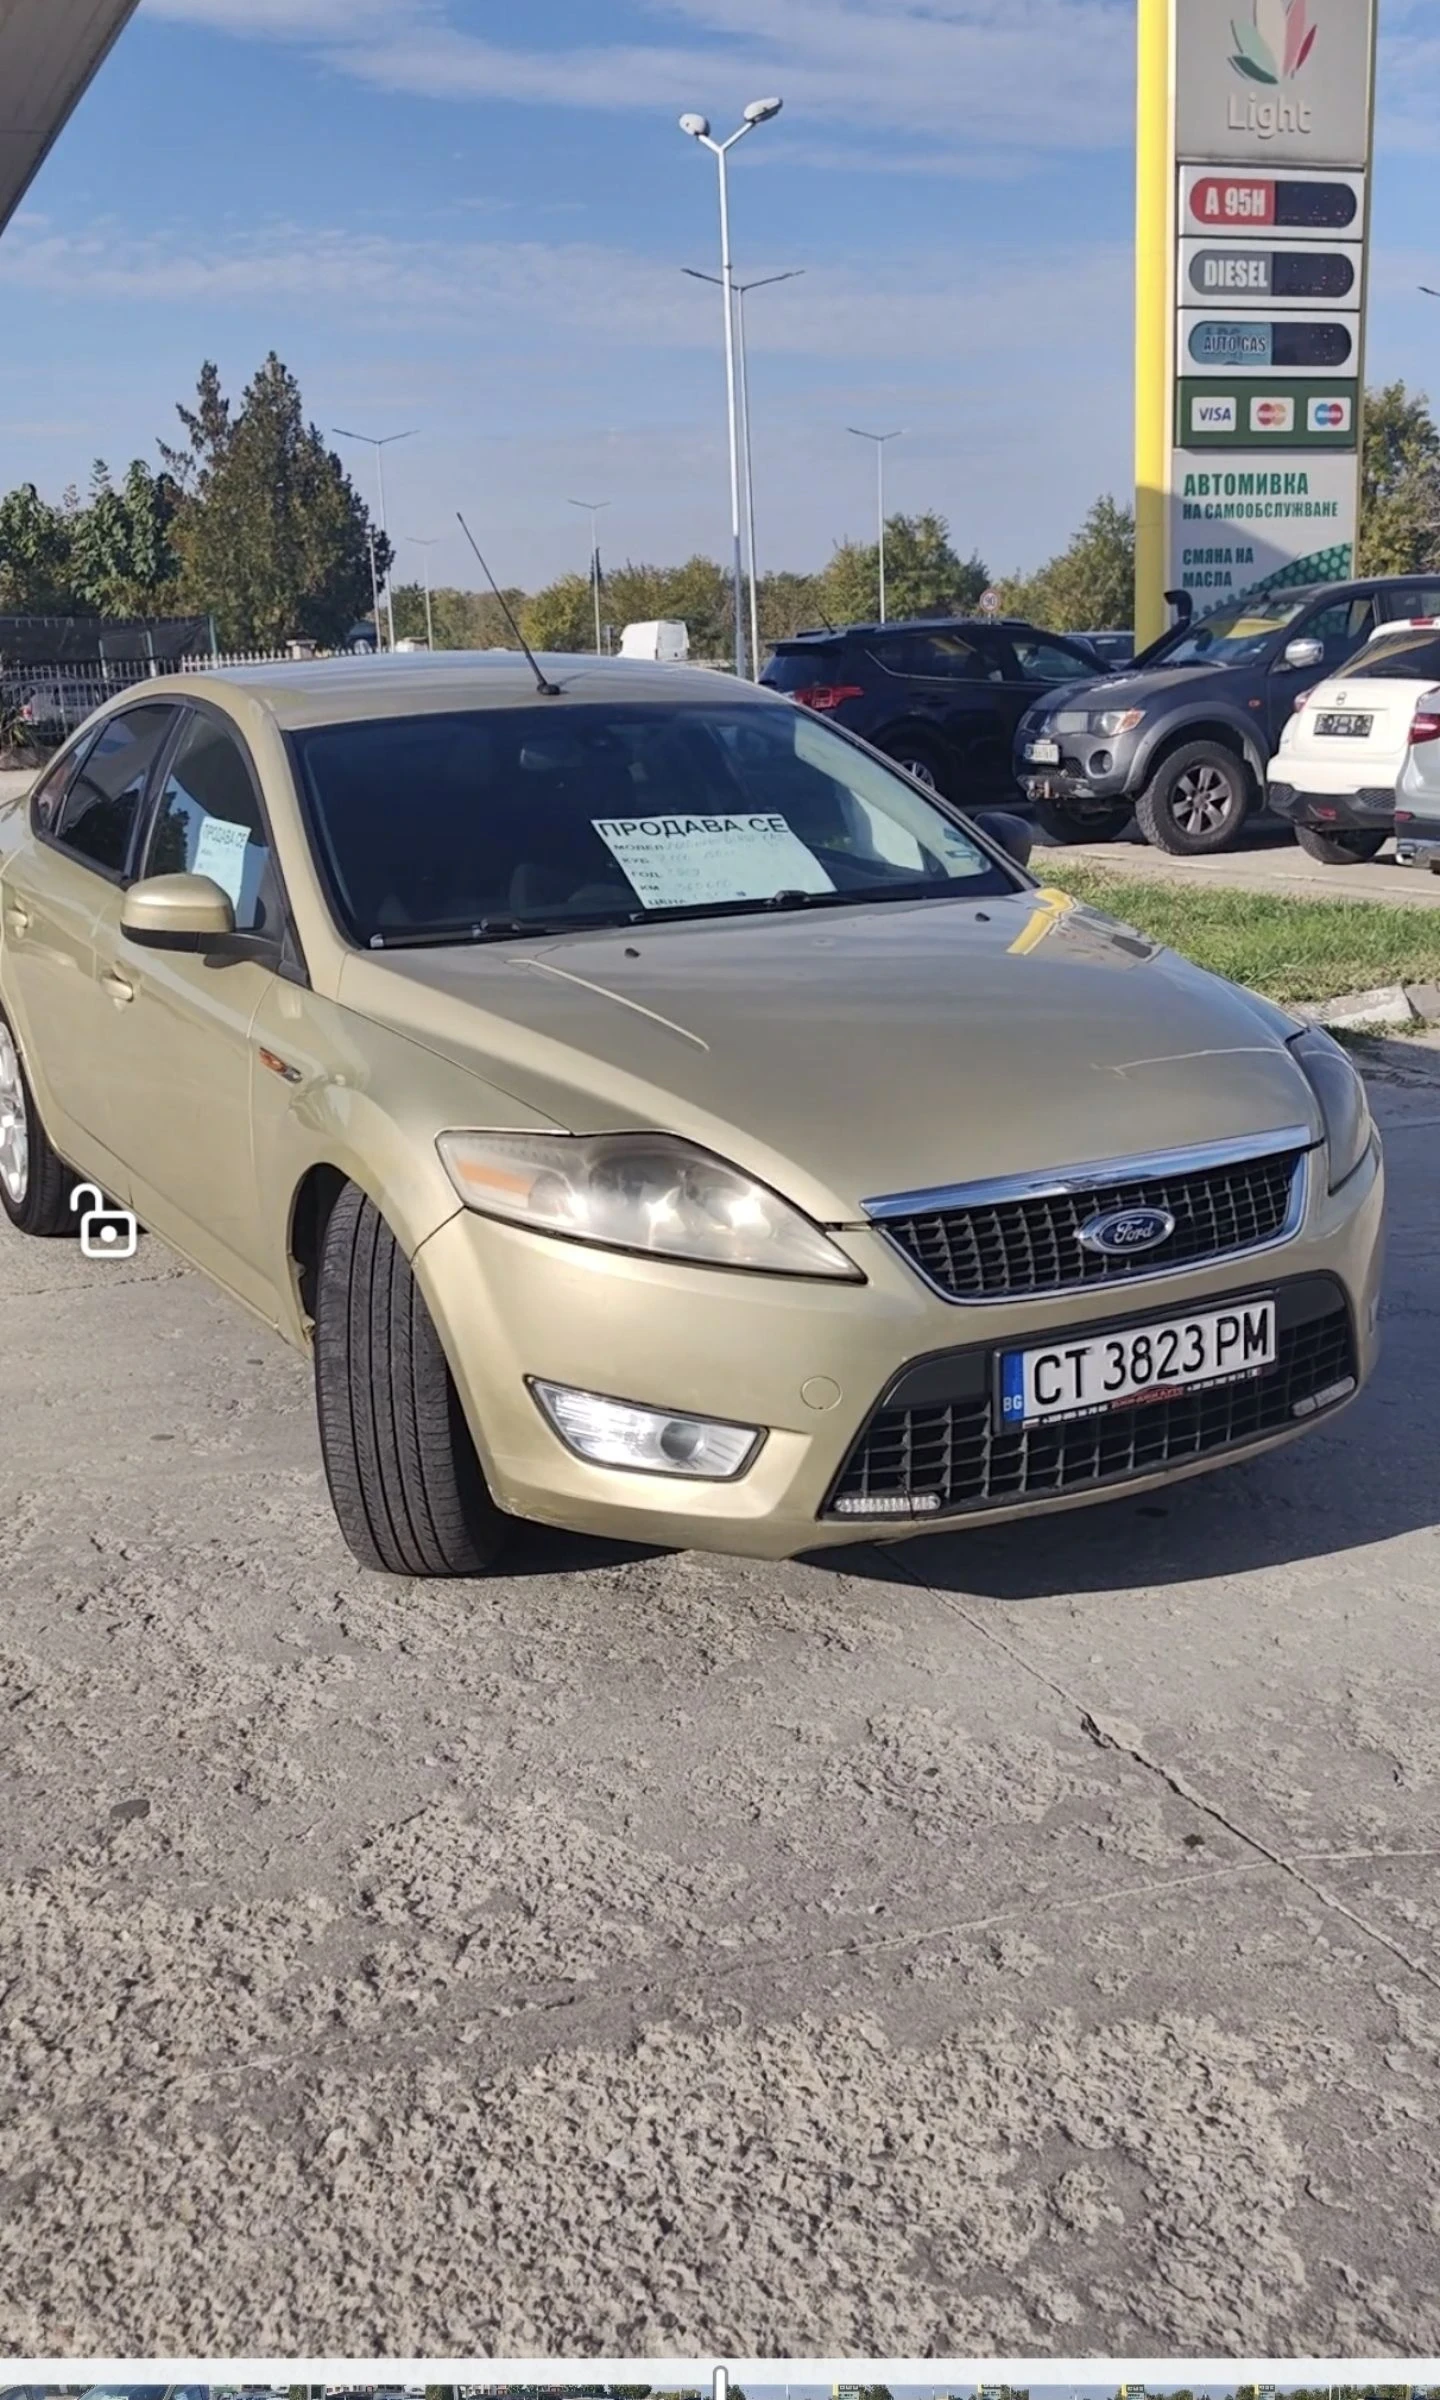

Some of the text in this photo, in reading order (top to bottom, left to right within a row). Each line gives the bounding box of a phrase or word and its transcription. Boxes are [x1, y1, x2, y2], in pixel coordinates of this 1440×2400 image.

[1227, 92, 1311, 140] Light
[1204, 187, 1266, 217] A 95H
[1204, 260, 1268, 288] DIESEL
[1203, 335, 1267, 353] AUTO GAS
[1199, 407, 1231, 421] VISA
[1183, 472, 1309, 497] АВТОМИВКА
[1183, 501, 1339, 520] НА САМООБСЛУЖВАНЕ
[1182, 547, 1254, 566] СМЯНА НА
[1182, 571, 1232, 588] МАСЛА
[598, 817, 789, 838] ПРОДАВА СЕ
[1113, 1219, 1154, 1244] Ford
[1034, 1308, 1268, 1405] CT 3823 PM
[1003, 1395, 1022, 1412] BG
